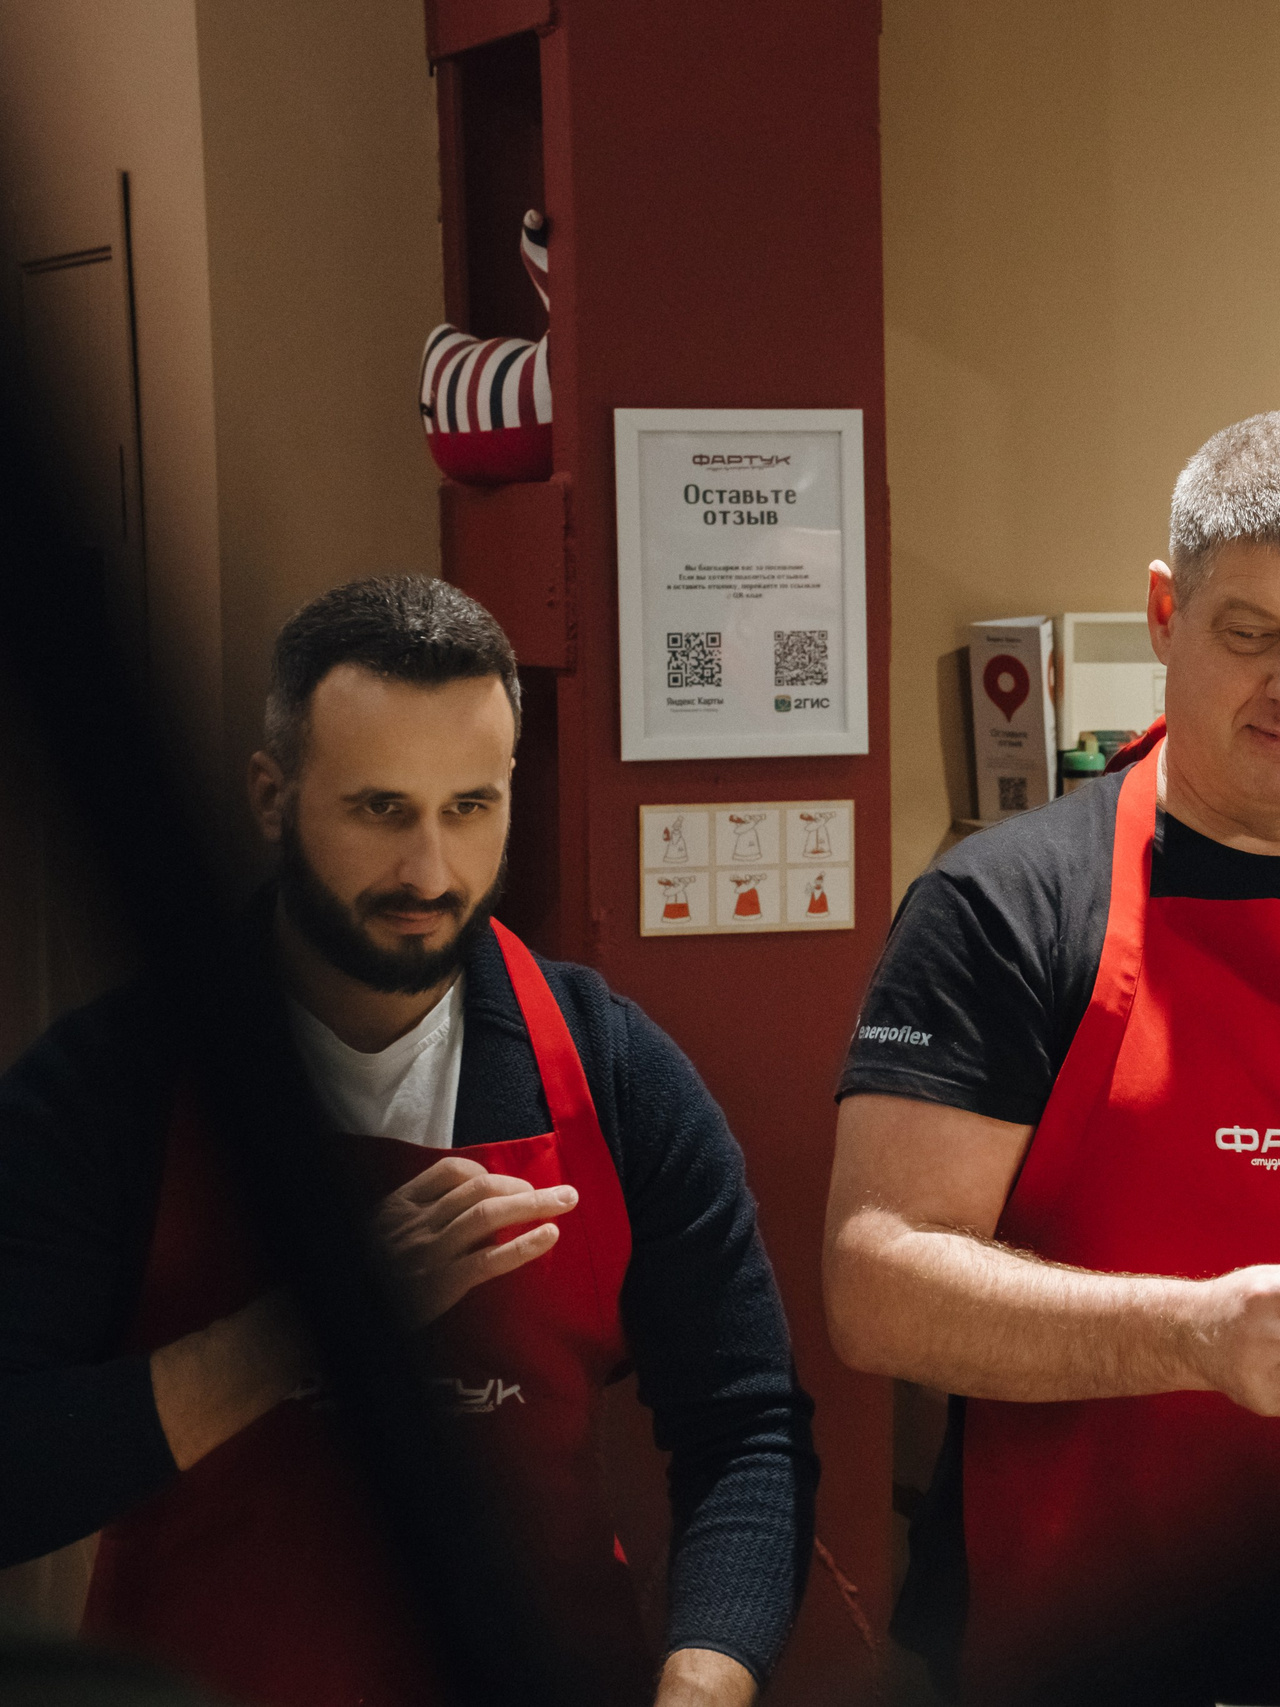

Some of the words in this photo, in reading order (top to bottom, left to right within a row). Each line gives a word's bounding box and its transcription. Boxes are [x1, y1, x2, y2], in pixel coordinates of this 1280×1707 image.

[692, 454, 791, 466] ФАРТУК
[683, 484, 797, 505] Оставьте
[703, 510, 779, 526] отзыв
[697, 697, 724, 706] Карты
[794, 697, 830, 709] 2ГИС
[859, 1025, 933, 1047] energoflex
